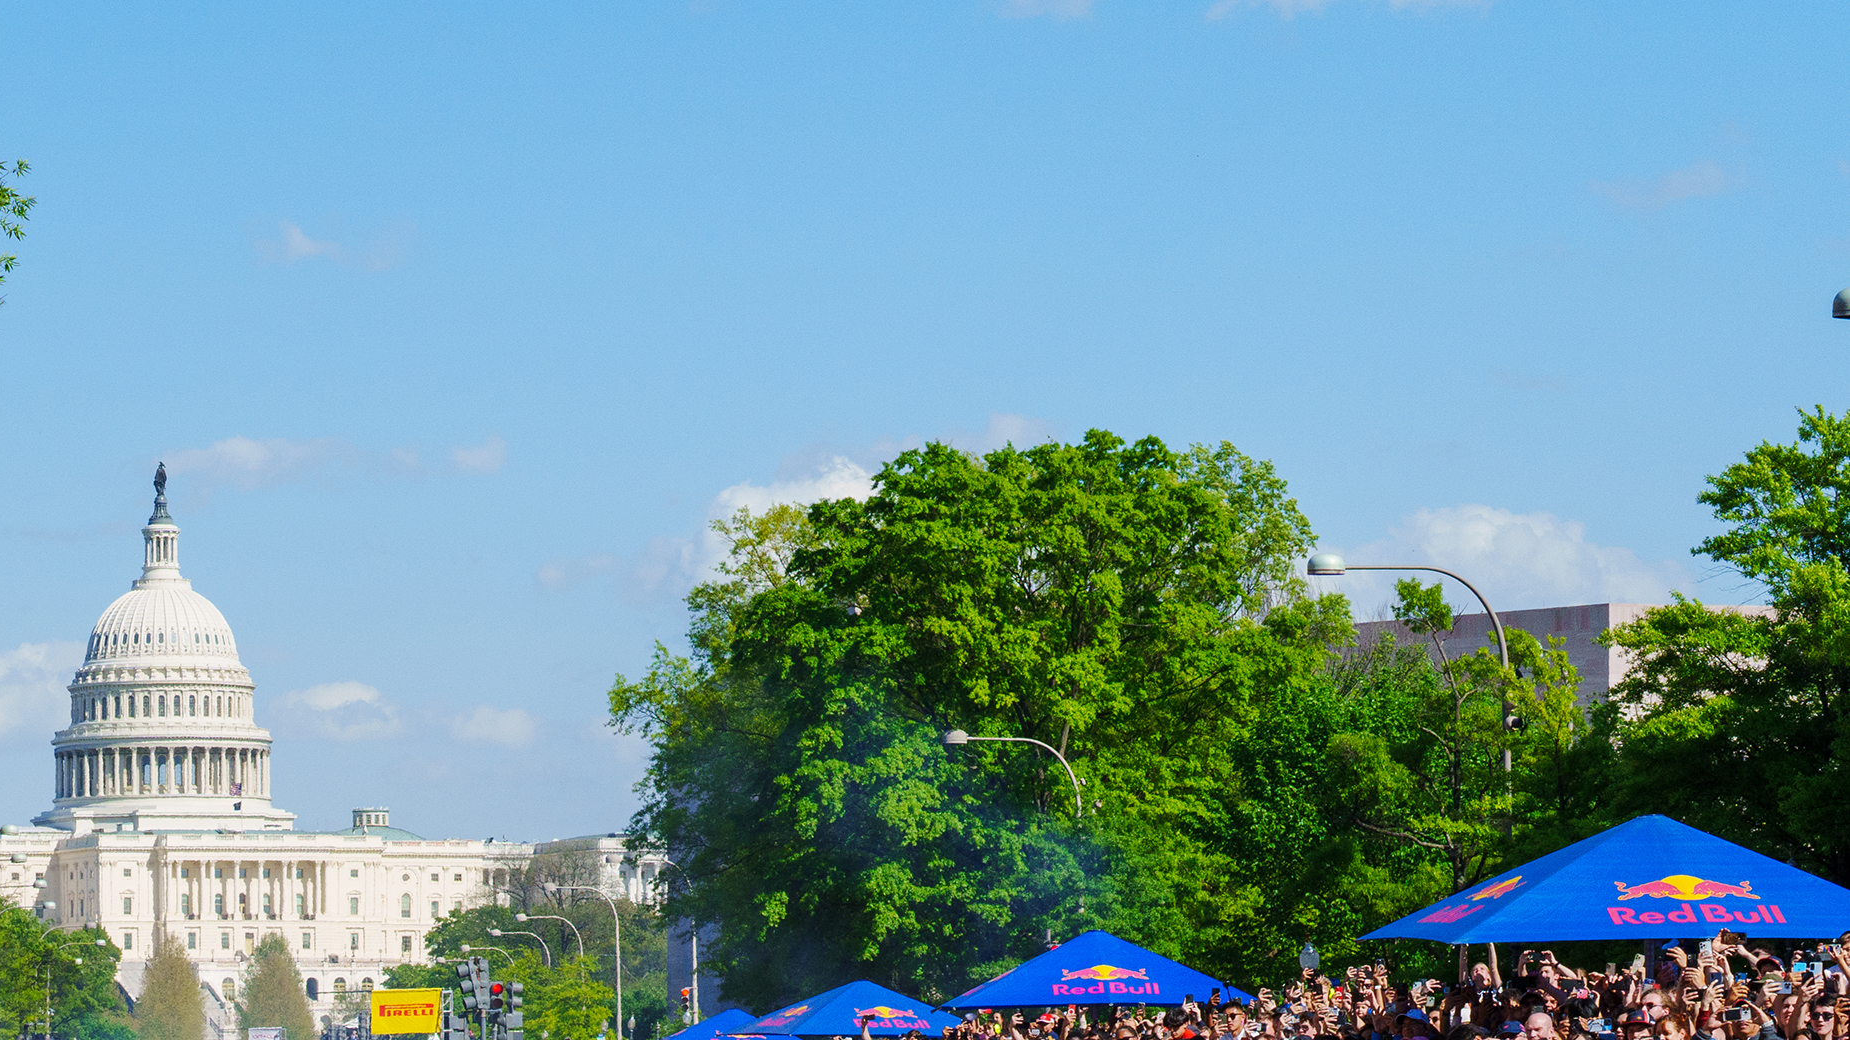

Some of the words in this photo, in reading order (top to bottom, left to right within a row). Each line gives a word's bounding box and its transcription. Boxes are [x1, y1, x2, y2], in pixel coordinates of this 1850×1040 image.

[1606, 904, 1697, 926] Red
[1698, 904, 1787, 925] Bull
[1052, 982, 1105, 996] Red
[1109, 982, 1160, 995] Bull
[379, 1003, 434, 1017] PIRELLI
[853, 1018, 893, 1028] Red
[894, 1019, 931, 1029] Bull
